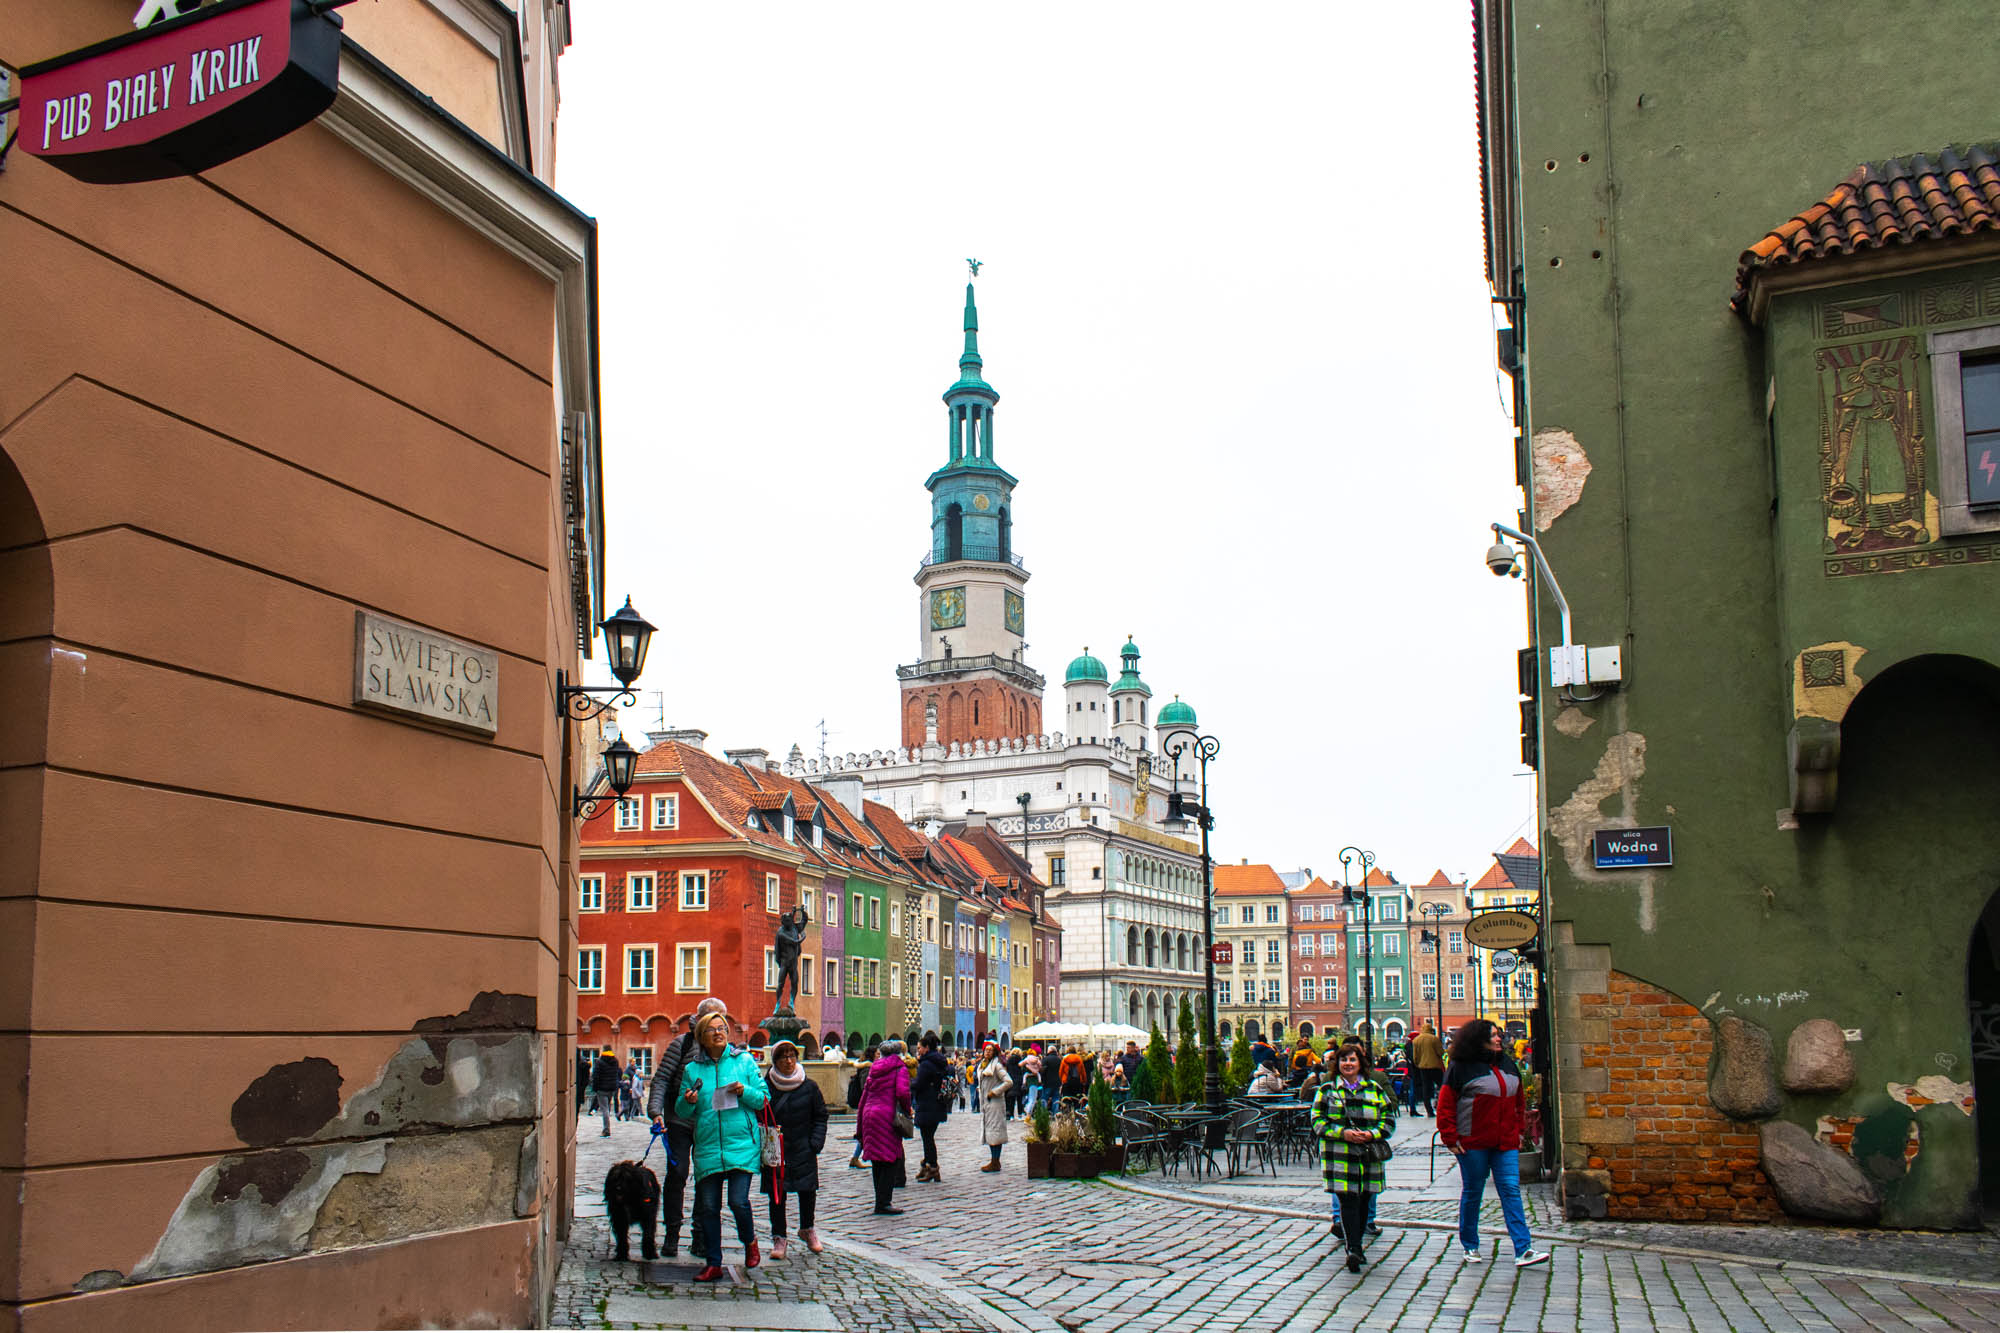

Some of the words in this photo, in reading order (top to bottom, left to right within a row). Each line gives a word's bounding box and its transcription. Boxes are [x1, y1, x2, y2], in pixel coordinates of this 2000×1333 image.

[41, 91, 93, 150] PUB
[103, 63, 176, 132] BIAŁY
[188, 34, 263, 105] KRUK
[1607, 840, 1659, 854] Wodna
[1473, 917, 1529, 933] Columbus
